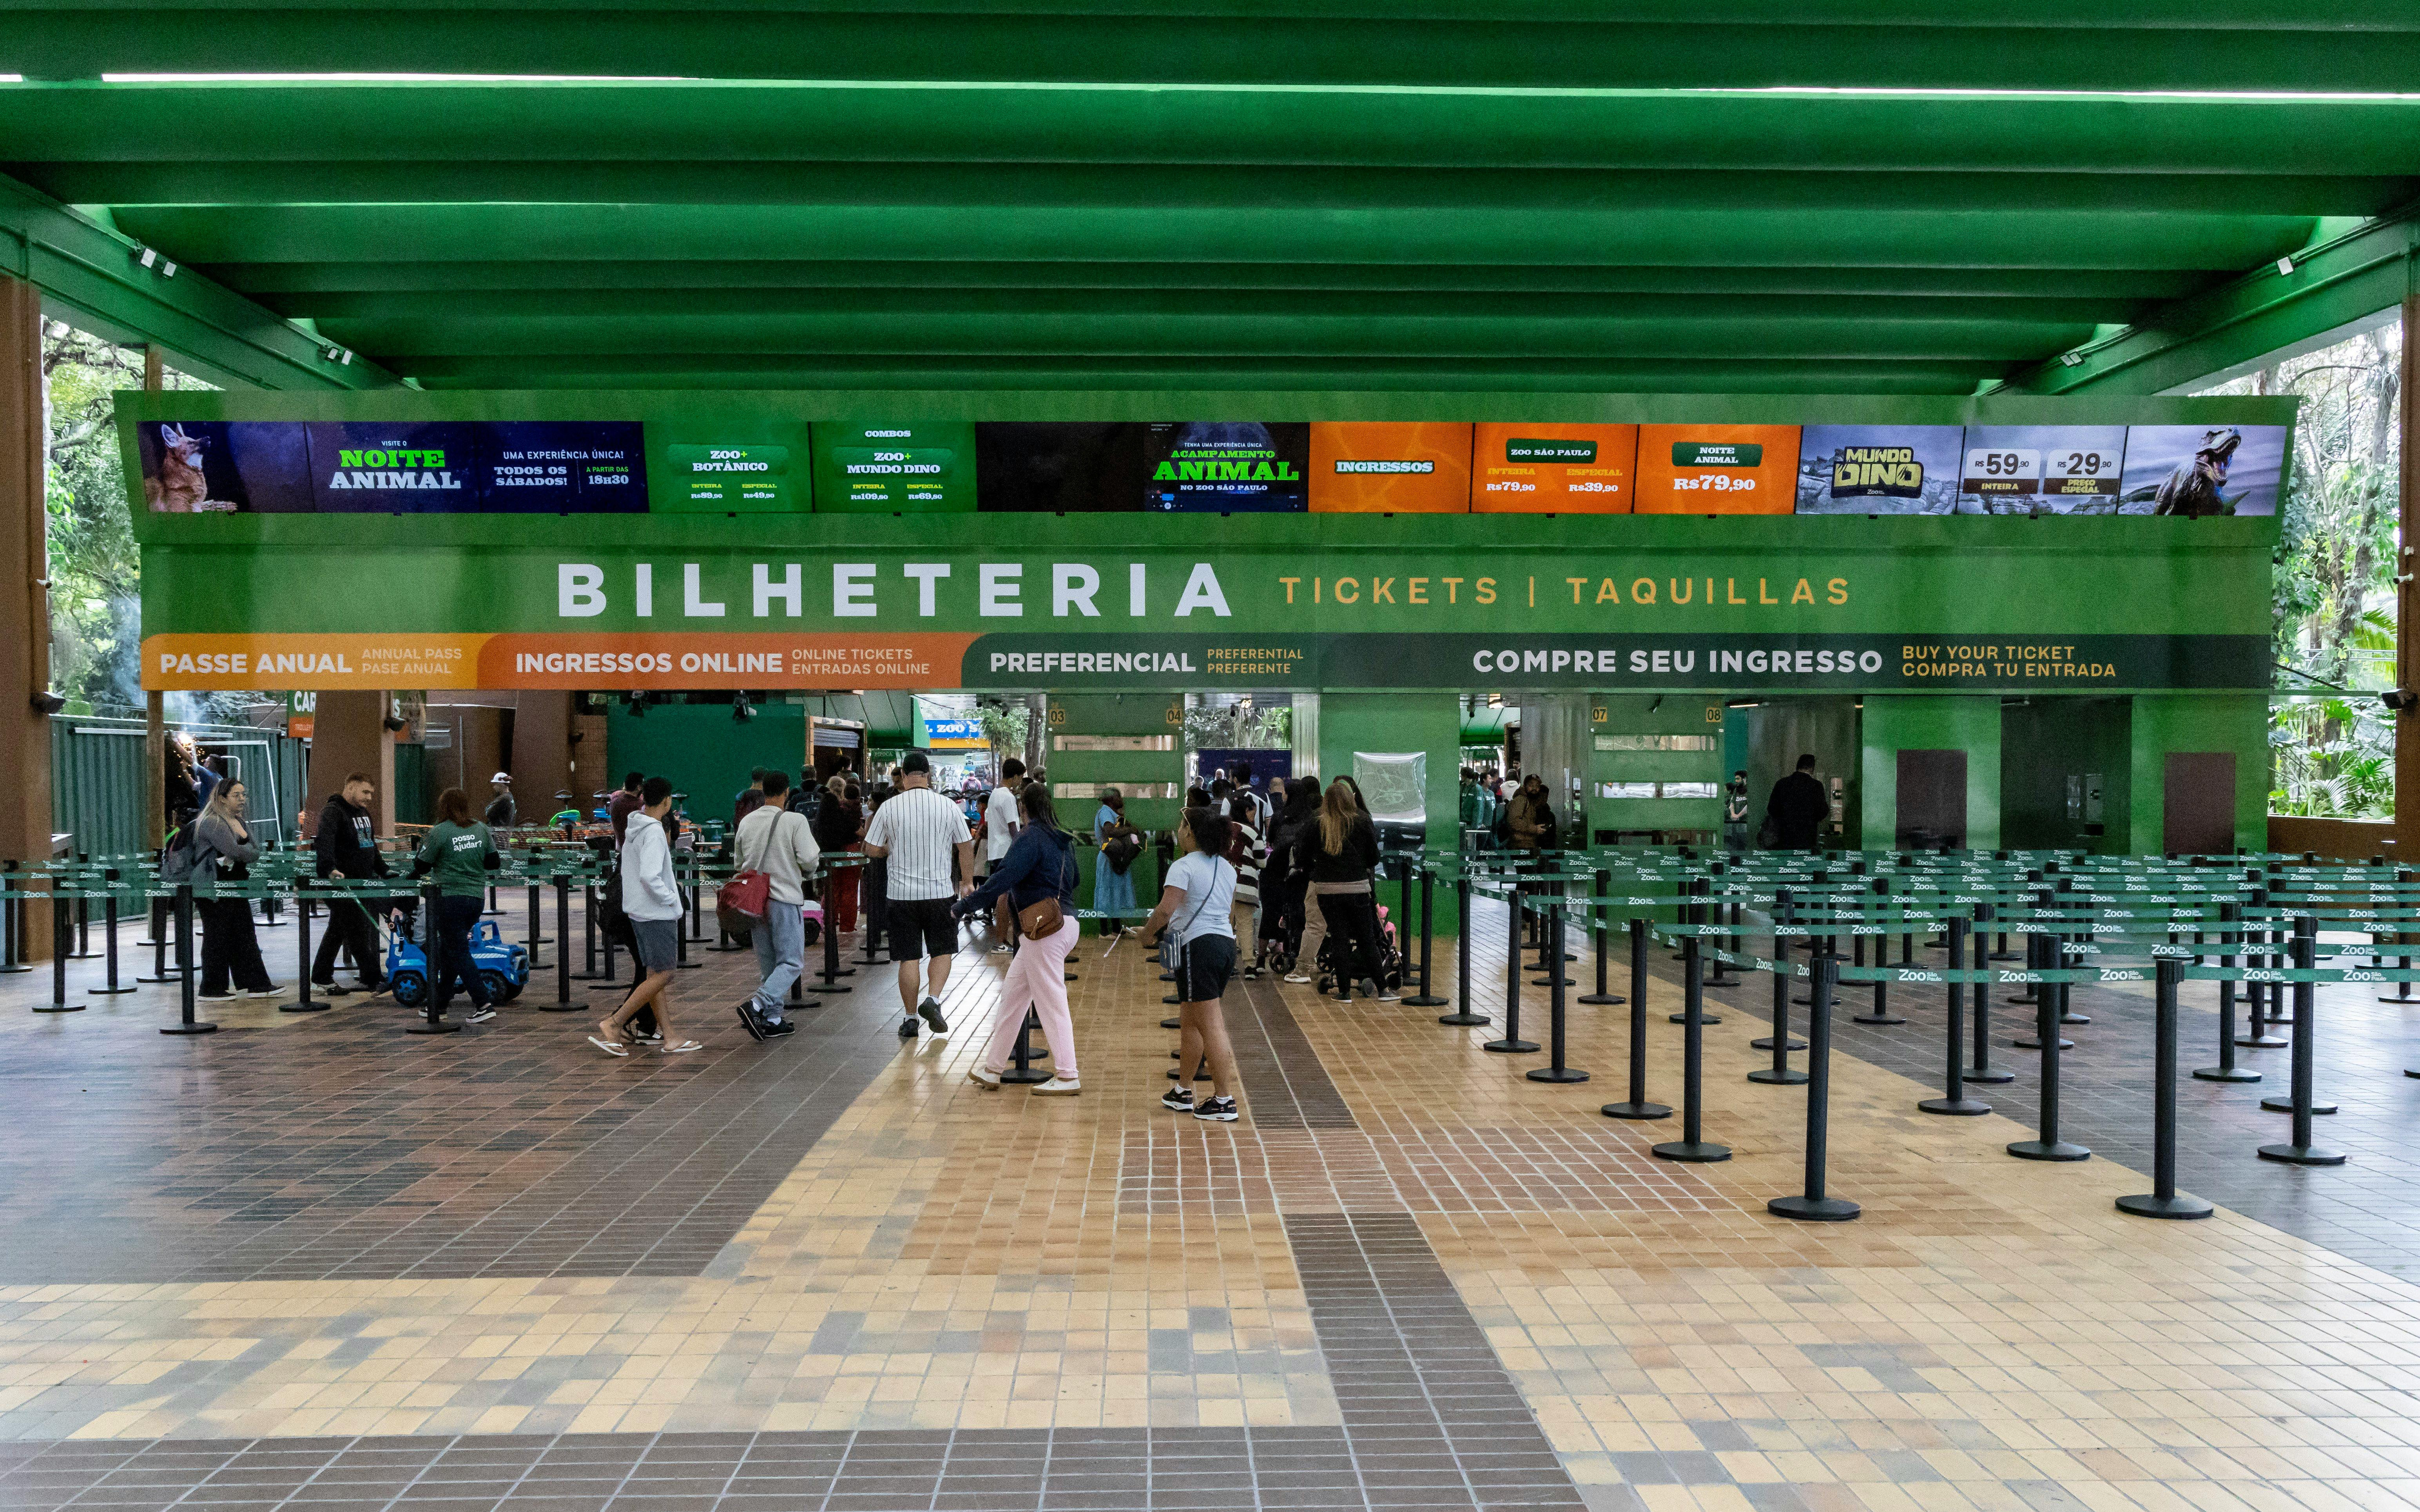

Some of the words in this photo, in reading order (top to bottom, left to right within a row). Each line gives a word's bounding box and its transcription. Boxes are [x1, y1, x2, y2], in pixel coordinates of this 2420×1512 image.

[528, 449, 588, 459] EXPERIÊNCIA
[592, 449, 623, 459] ÚNICA!
[711, 451, 748, 459] ZOO+
[874, 453, 912, 461] ZOO+
[1534, 447, 1555, 456] SÃO
[1845, 449, 1911, 462] MUNDO
[339, 450, 444, 467] NOITE
[693, 460, 768, 471] BOTÂNICO
[904, 465, 940, 473] DINO
[1153, 461, 1299, 480] ANIMAL
[1337, 462, 1432, 472] INGRESSOS
[330, 472, 460, 488] ANIMAL
[496, 476, 567, 485] SÁBADOS!
[589, 475, 629, 484] 18H30
[1834, 464, 1921, 487] DINO
[1673, 475, 1755, 491] R$79,90
[559, 563, 1231, 617] BILHETERIA
[1280, 578, 1496, 604] TICKETS
[1566, 578, 1847, 605] TAQUILLAS
[362, 649, 421, 659] ANNUAL
[425, 648, 461, 659] PASS
[792, 649, 846, 659] ONLINE
[851, 649, 912, 659] TICKETS
[1208, 649, 1303, 659] PREFERENTIAL
[1903, 646, 1940, 659] BUY
[1947, 646, 1998, 659] YOUR
[2006, 646, 2074, 659] TICKET
[161, 654, 247, 673] PASSE
[256, 654, 352, 673] ANUAL
[517, 653, 672, 672] INGRESSOS
[681, 653, 782, 672] ONLINE
[991, 653, 1196, 672] PREFERENCIAL
[1474, 650, 1615, 672] COMPRE
[1630, 650, 1694, 672] SEU
[1710, 650, 1882, 672] INGRESSO
[362, 663, 399, 674] PASE
[403, 663, 451, 674] ANUAL
[792, 664, 870, 674] ENTRADAS
[876, 664, 929, 674] ONLINE
[1208, 663, 1290, 673] PREFERENTE
[1903, 663, 1986, 676] COMPRA
[1994, 663, 2017, 676] TU
[2026, 663, 2115, 676] ENTRADA
[1051, 710, 1065, 723] 03
[1167, 710, 1181, 723] 04
[1592, 709, 1606, 721] 07
[1707, 708, 1721, 721] 08
[937, 725, 965, 733] ZOO
[452, 834, 475, 845] posso
[453, 840, 482, 852] ajudar?
[1699, 925, 1719, 934] Zoo
[1775, 925, 1796, 934] Zoo
[1852, 925, 1872, 934] Zoo
[2063, 943, 2087, 953] Zoo
[2240, 944, 2264, 954] Zoo
[2341, 945, 2365, 955] Zoo
[1899, 969, 1926, 981] Zoo
[2000, 971, 2027, 982] Zoo
[2101, 969, 2128, 980] Zoo
[2243, 968, 2270, 980] Zoo
[2343, 970, 2370, 981] Zoo
